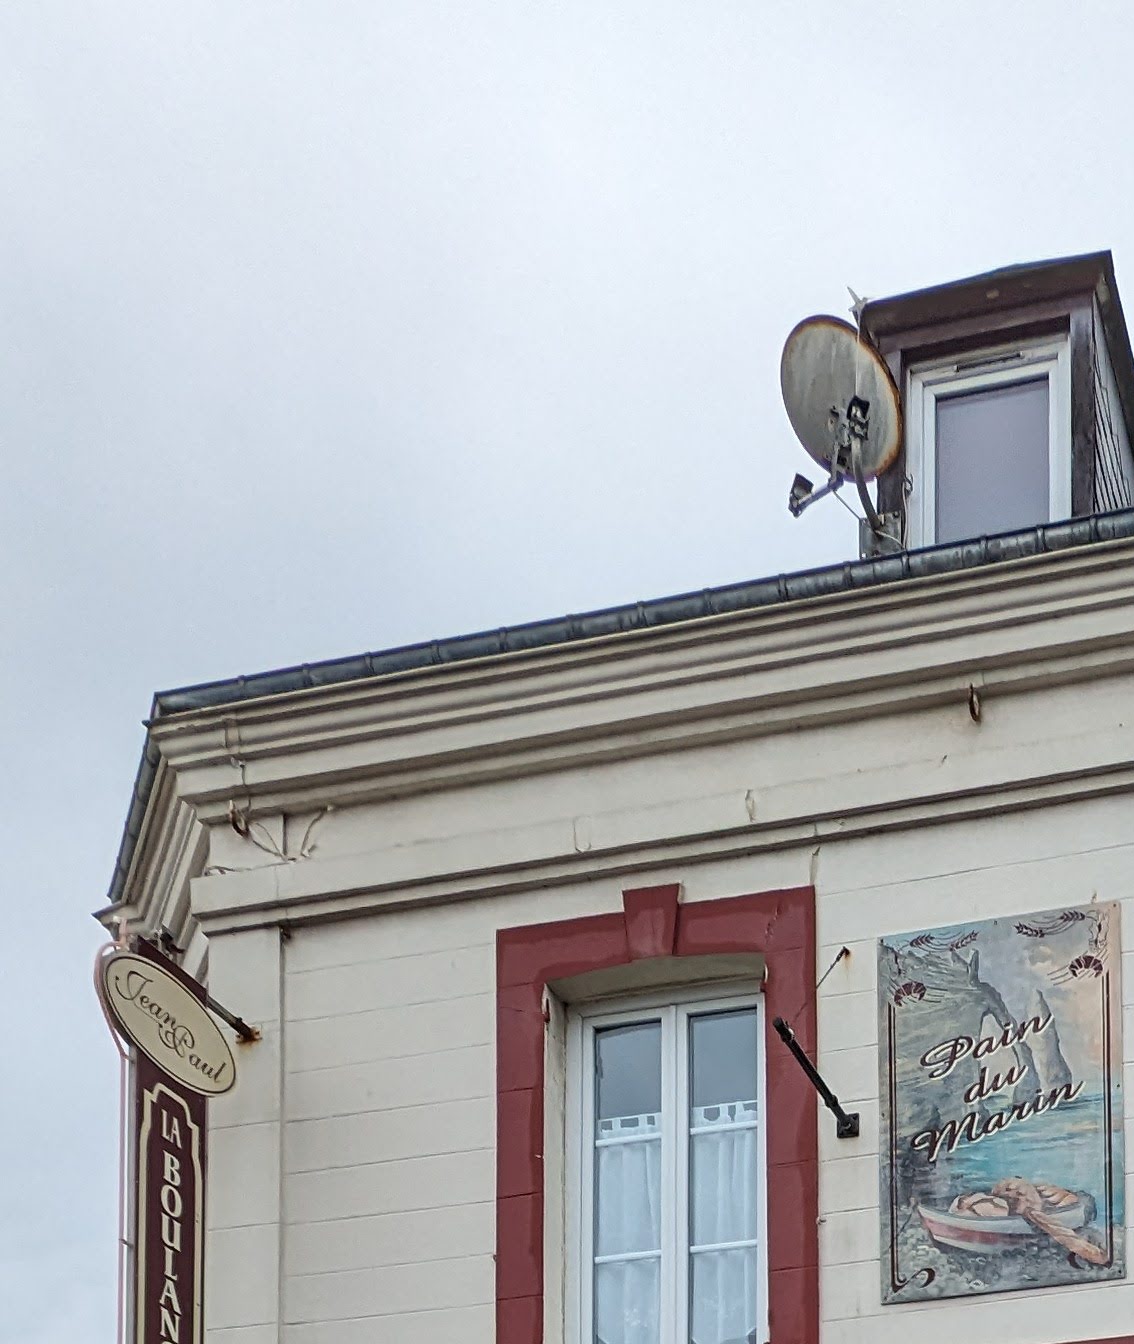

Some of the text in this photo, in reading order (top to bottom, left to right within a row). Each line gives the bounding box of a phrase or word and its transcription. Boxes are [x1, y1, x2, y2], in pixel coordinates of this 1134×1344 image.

[115, 970, 176, 1031] Jean
[159, 1025, 227, 1083] Paul
[920, 1013, 1054, 1080] Pain
[964, 1065, 1028, 1104] du
[161, 1108, 182, 1149] LA
[910, 1080, 1086, 1163] Marin
